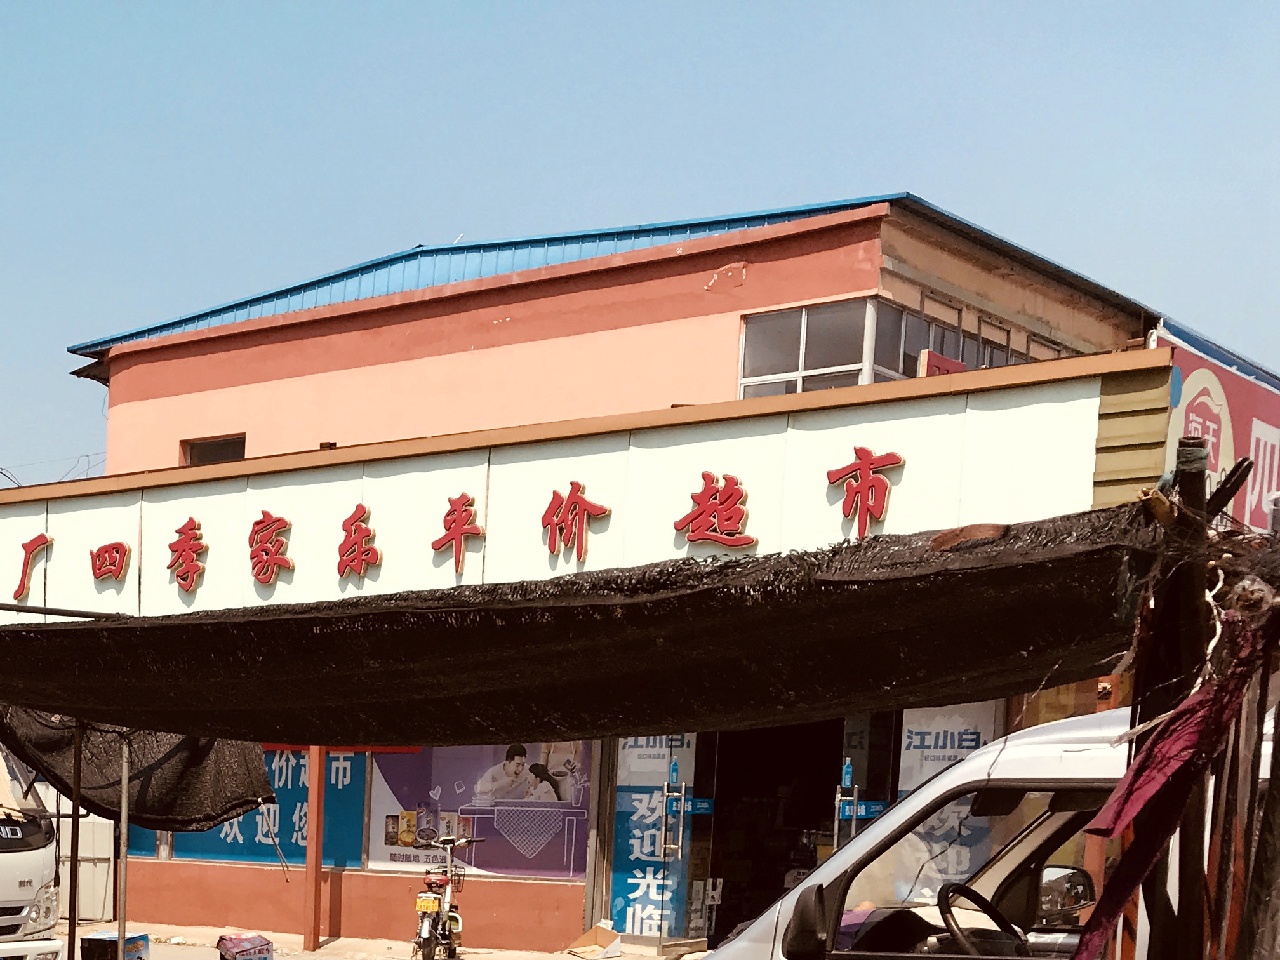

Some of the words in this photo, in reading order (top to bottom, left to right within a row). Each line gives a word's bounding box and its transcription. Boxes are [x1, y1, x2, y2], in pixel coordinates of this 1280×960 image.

[904, 728, 981, 750] 江小白
[625, 790, 677, 936] 欢迎光临
